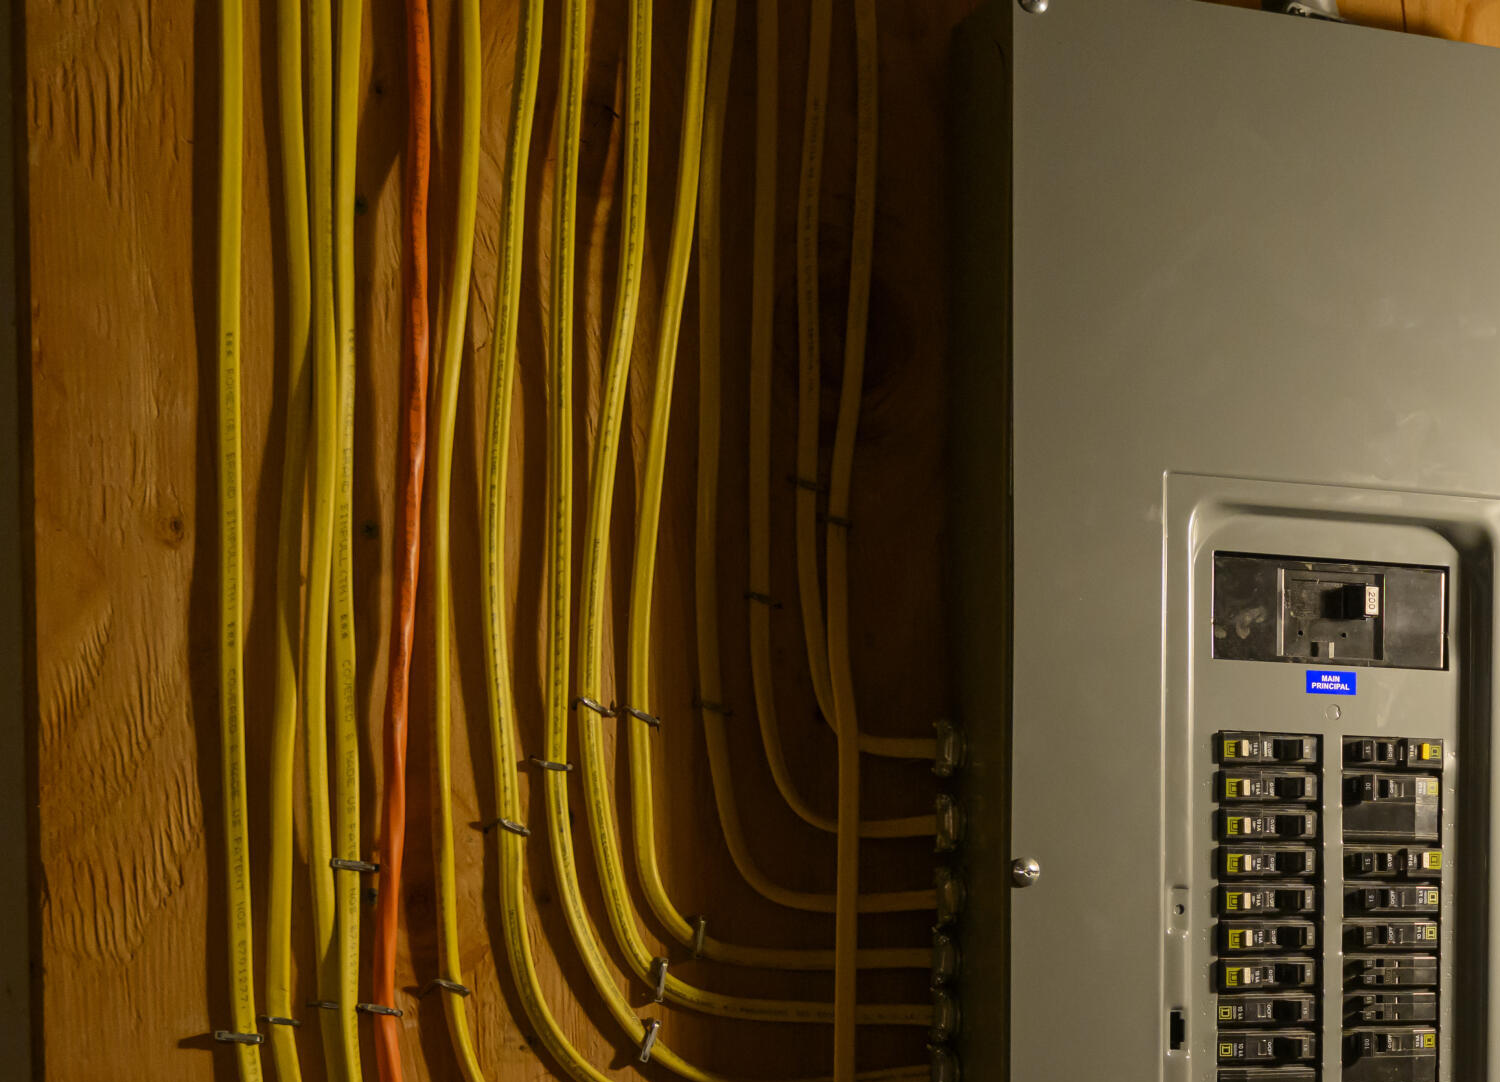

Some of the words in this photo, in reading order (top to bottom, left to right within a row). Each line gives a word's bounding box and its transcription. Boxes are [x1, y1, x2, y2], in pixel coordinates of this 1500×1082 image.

[1321, 675, 1340, 683] MAIN
[1312, 682, 1350, 691] PRINCIPAL
[232, 835, 244, 893] PATENT
